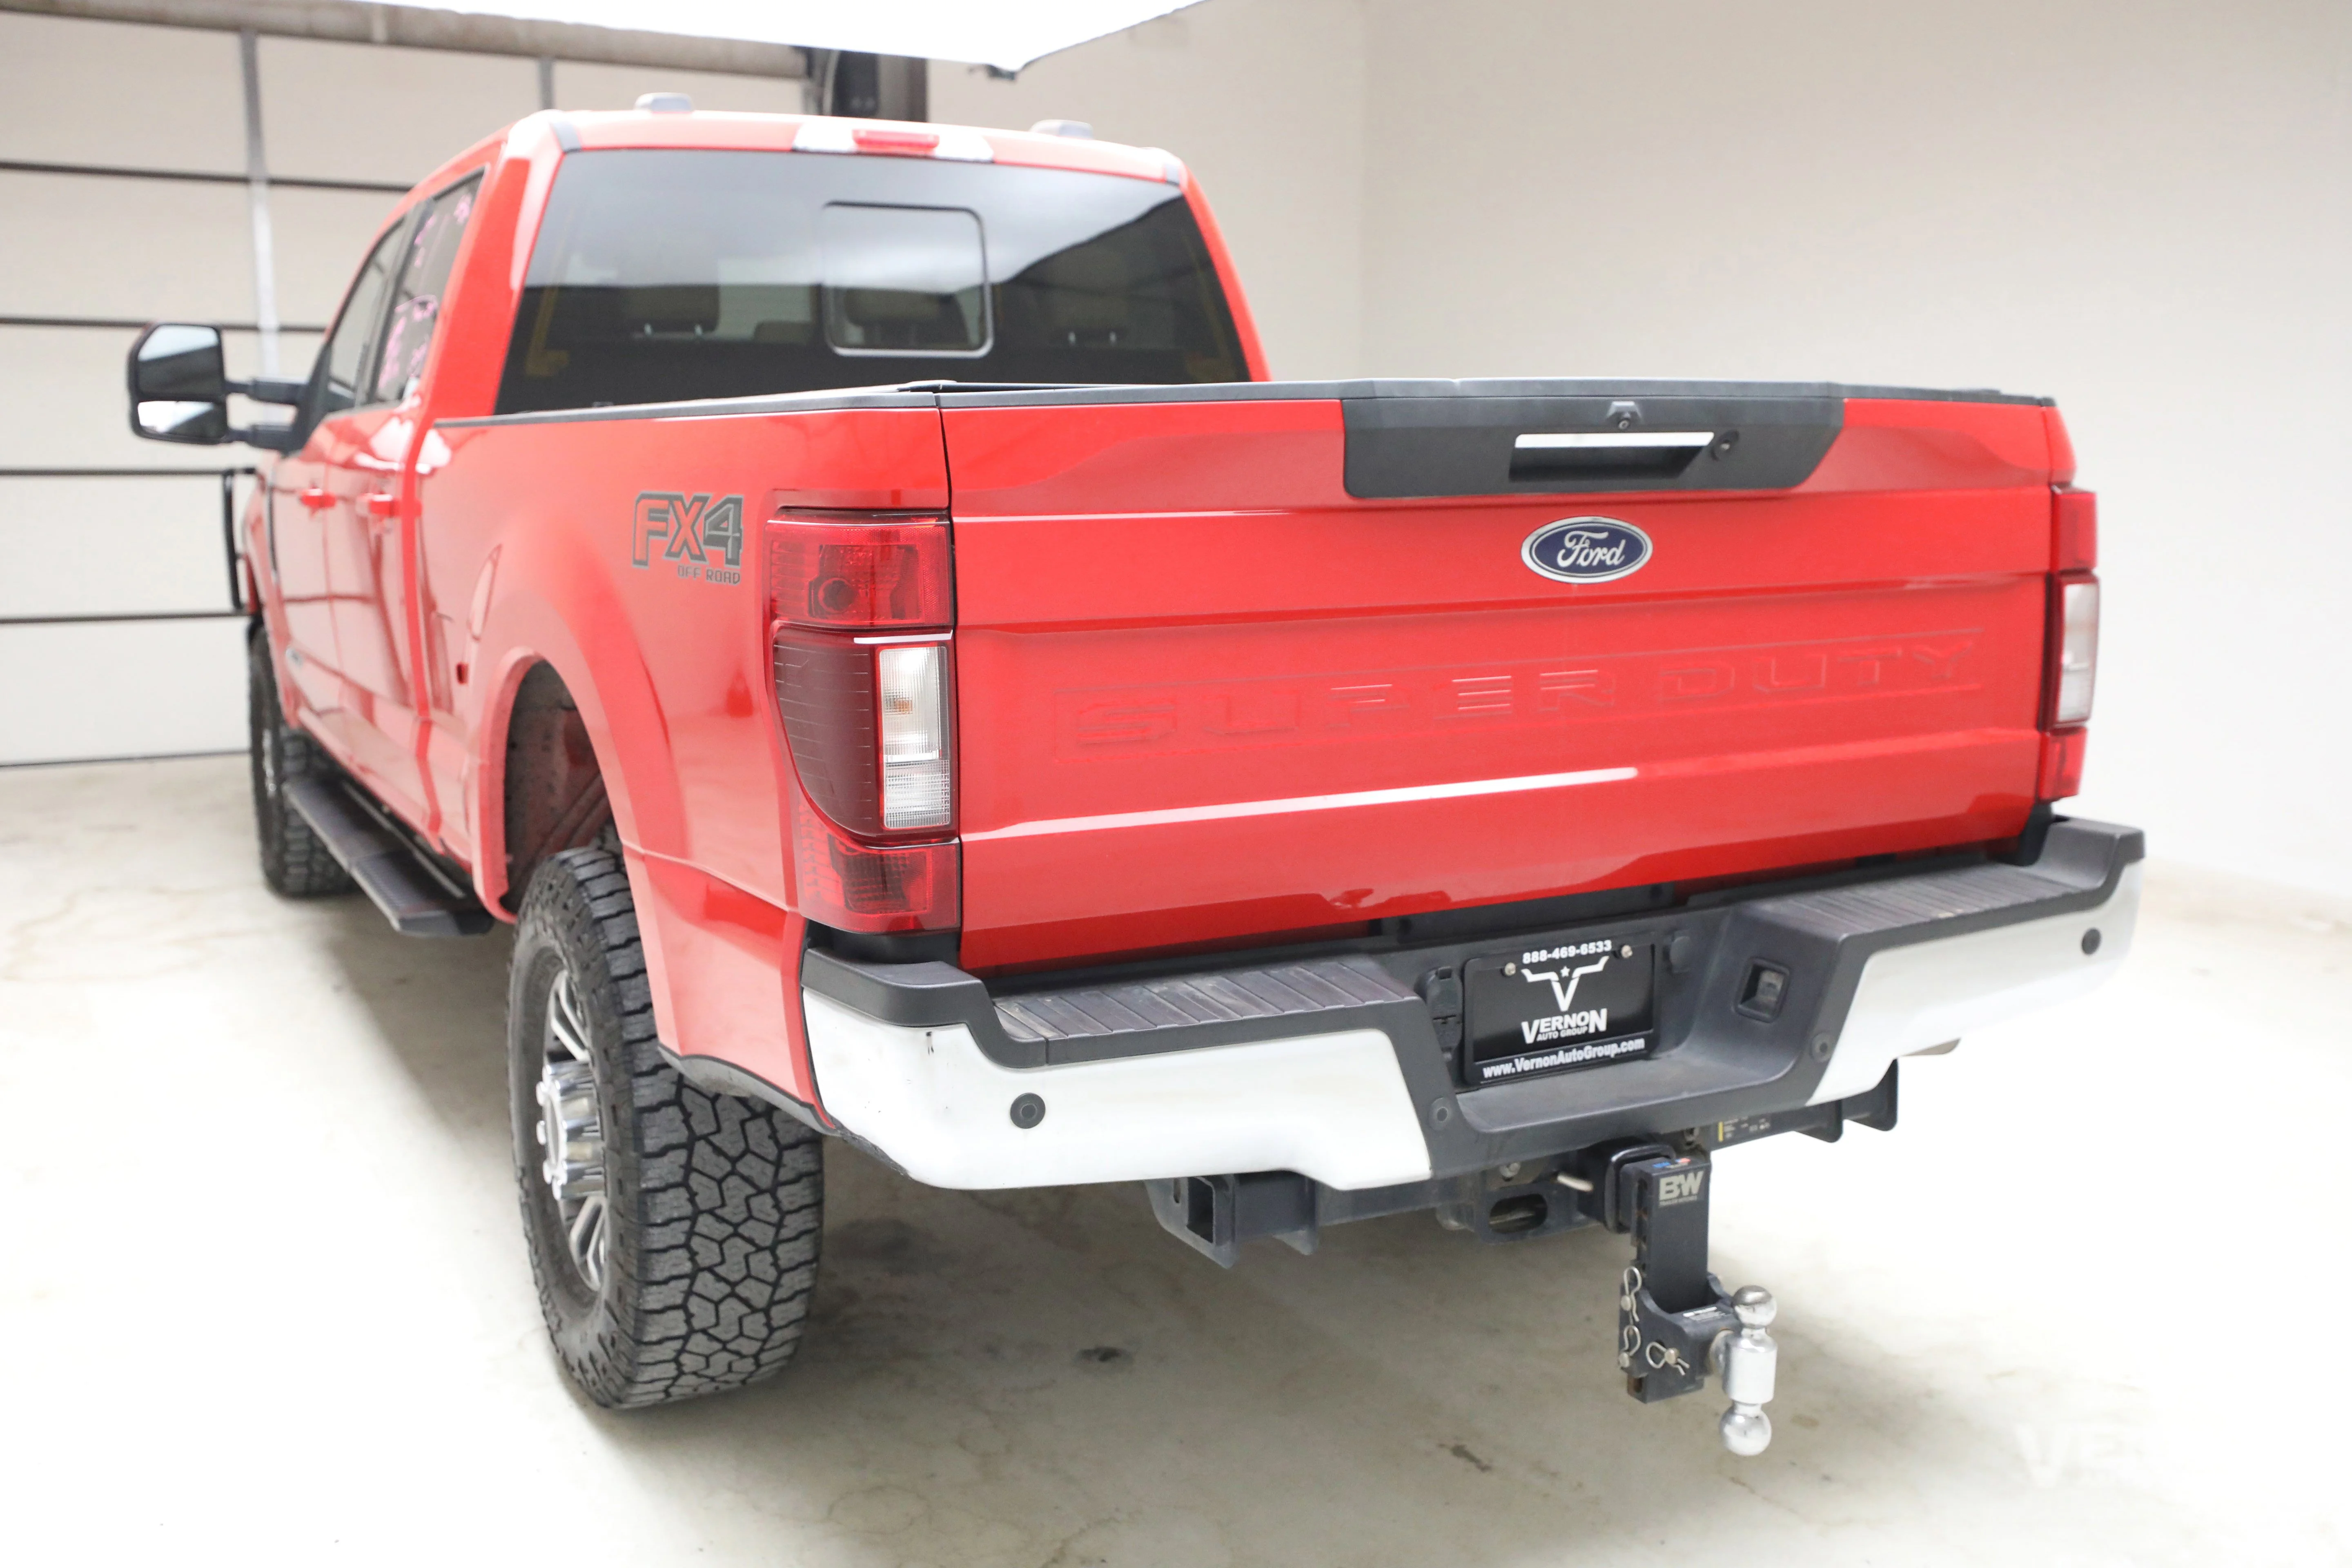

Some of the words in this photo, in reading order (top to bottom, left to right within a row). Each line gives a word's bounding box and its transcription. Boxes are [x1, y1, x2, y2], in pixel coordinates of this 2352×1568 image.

[632, 490, 744, 570] FX4
[1557, 530, 1626, 568] Ford
[677, 564, 701, 580] OFF
[705, 568, 741, 586] ROAD
[1076, 668, 1616, 746] SUPER
[1659, 639, 1975, 703] DUTY
[1522, 940, 1612, 964] 888-469-6533
[1521, 1008, 1608, 1044] VERNON
[1537, 1031, 1559, 1042] AUTO
[1559, 1025, 1588, 1038] GROUP
[1483, 1038, 1645, 1078] www.VernonAutoGroup.com
